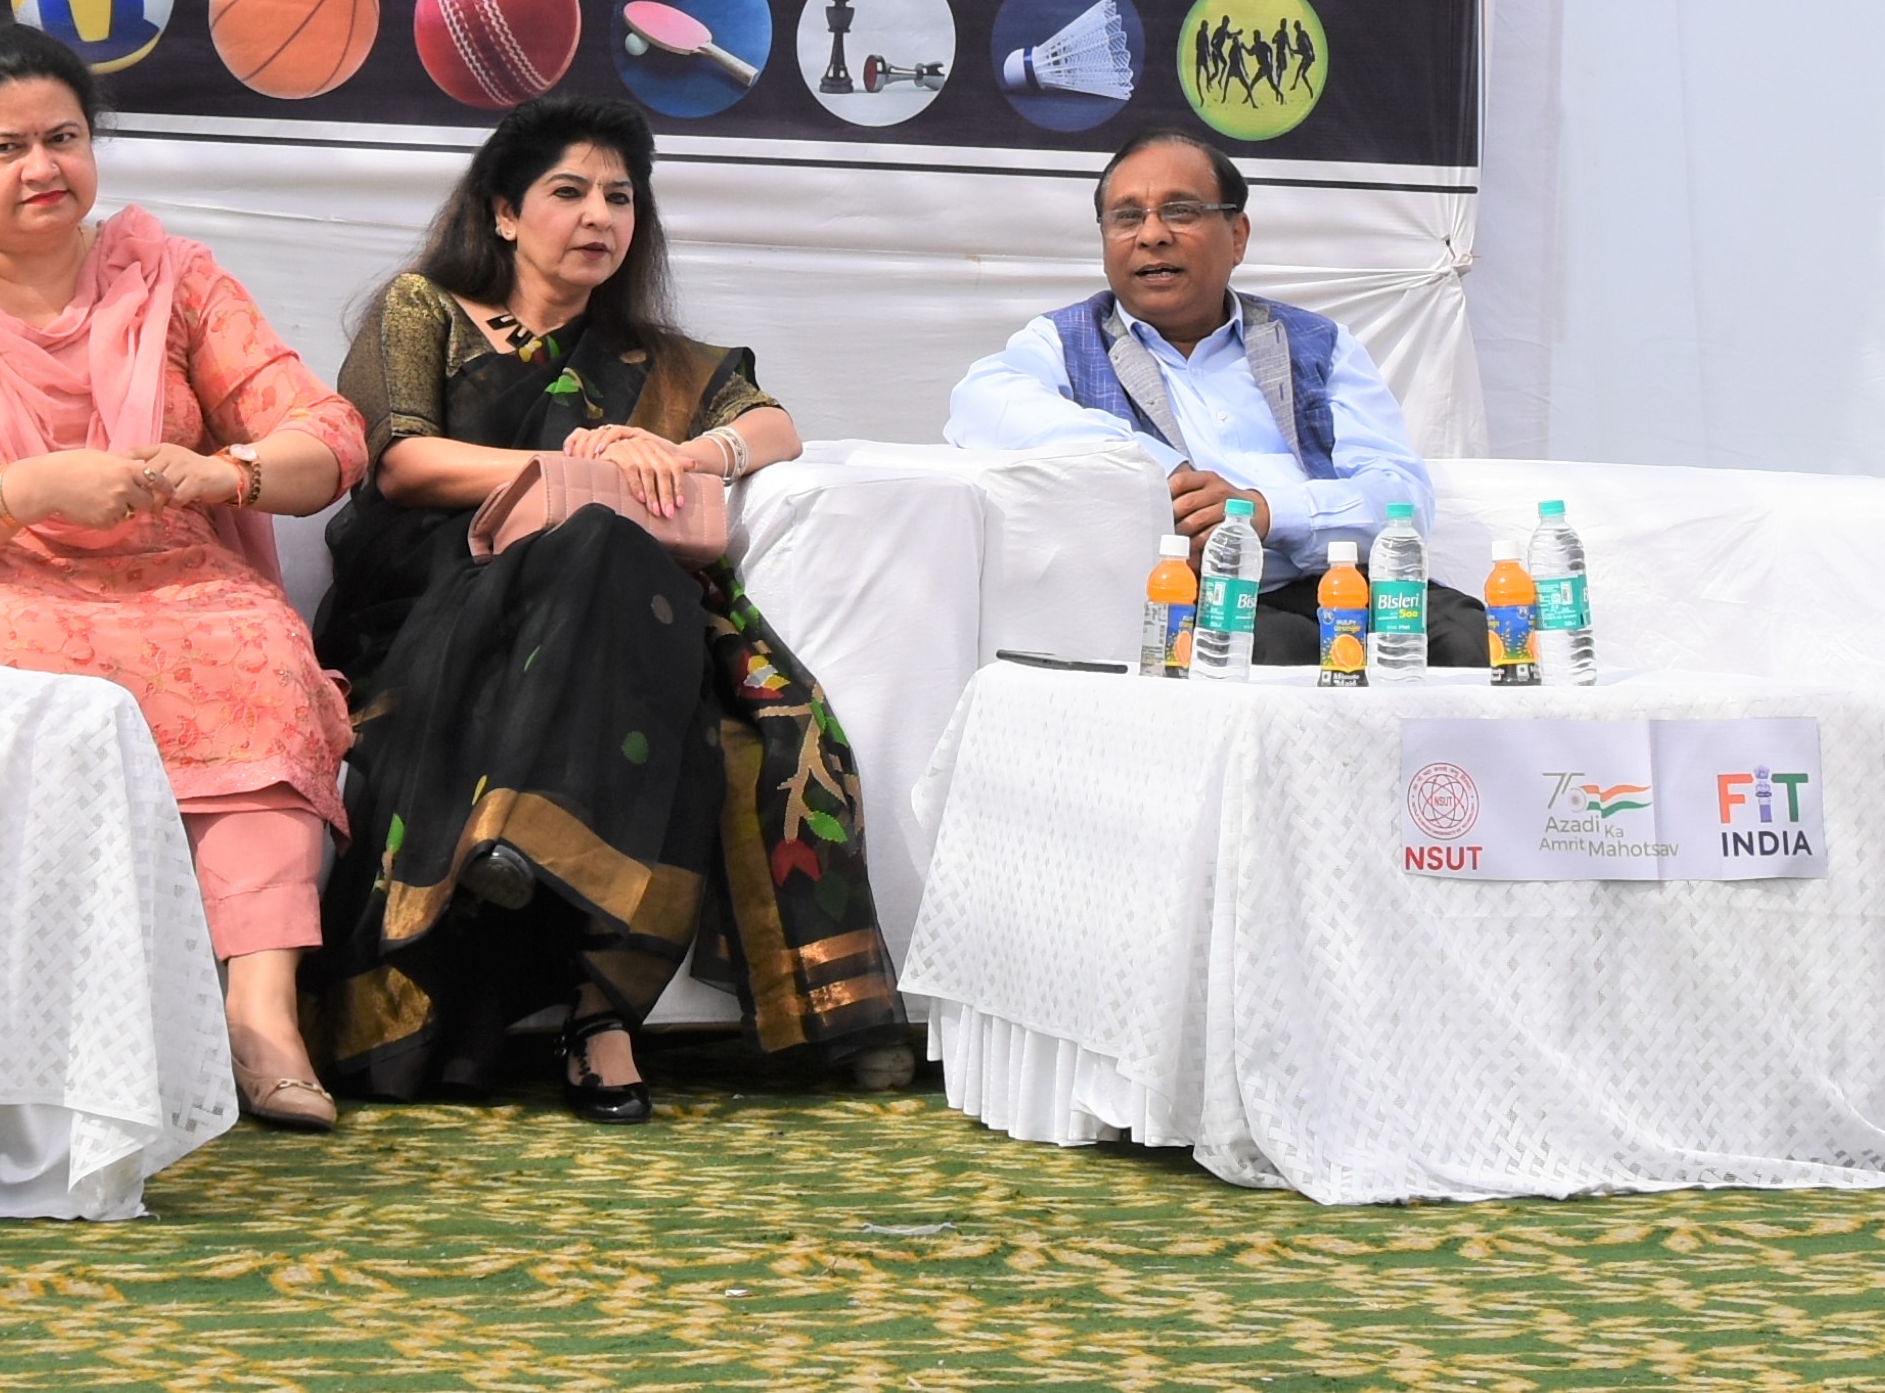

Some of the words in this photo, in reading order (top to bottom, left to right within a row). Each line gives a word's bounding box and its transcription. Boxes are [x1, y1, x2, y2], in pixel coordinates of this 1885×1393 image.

[1378, 592, 1420, 610] Bisleri
[1434, 796, 1453, 807] NSUT
[1545, 815, 1600, 833] Azadi
[1604, 824, 1624, 838] Ka
[1539, 837, 1585, 852] Amrit
[1589, 840, 1679, 858] Mahotsav
[1721, 830, 1813, 858] INDIA
[1405, 846, 1483, 871] NSUT
